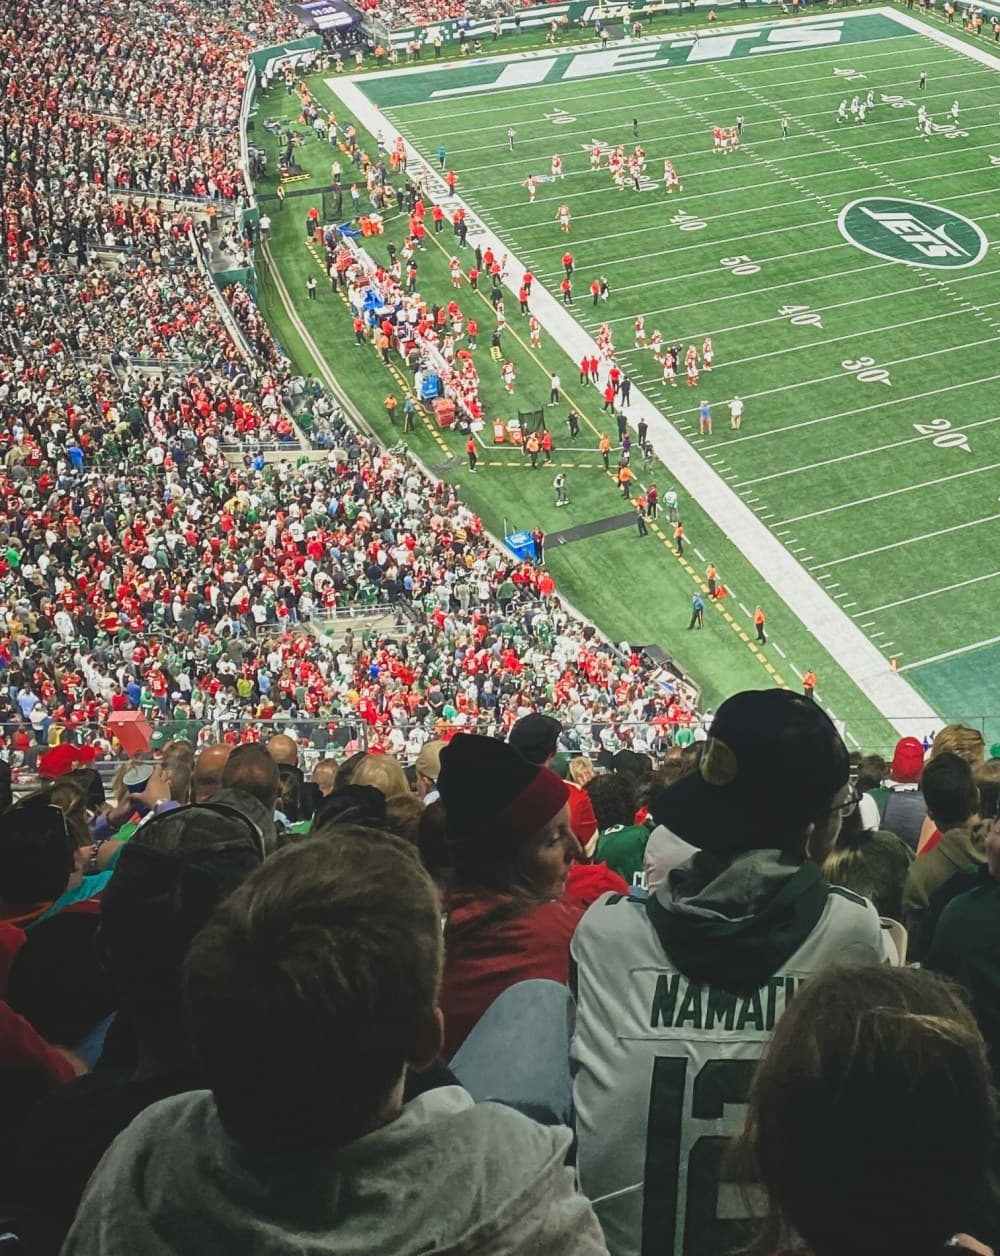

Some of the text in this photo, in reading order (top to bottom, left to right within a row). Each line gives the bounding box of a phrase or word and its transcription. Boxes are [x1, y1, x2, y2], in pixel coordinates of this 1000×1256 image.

[429, 20, 846, 98] JETS
[668, 214, 708, 232] 40
[857, 206, 972, 258] JETS
[719, 254, 762, 276] 50
[777, 304, 822, 326] 40
[841, 356, 890, 383] 30
[912, 417, 968, 448] 20
